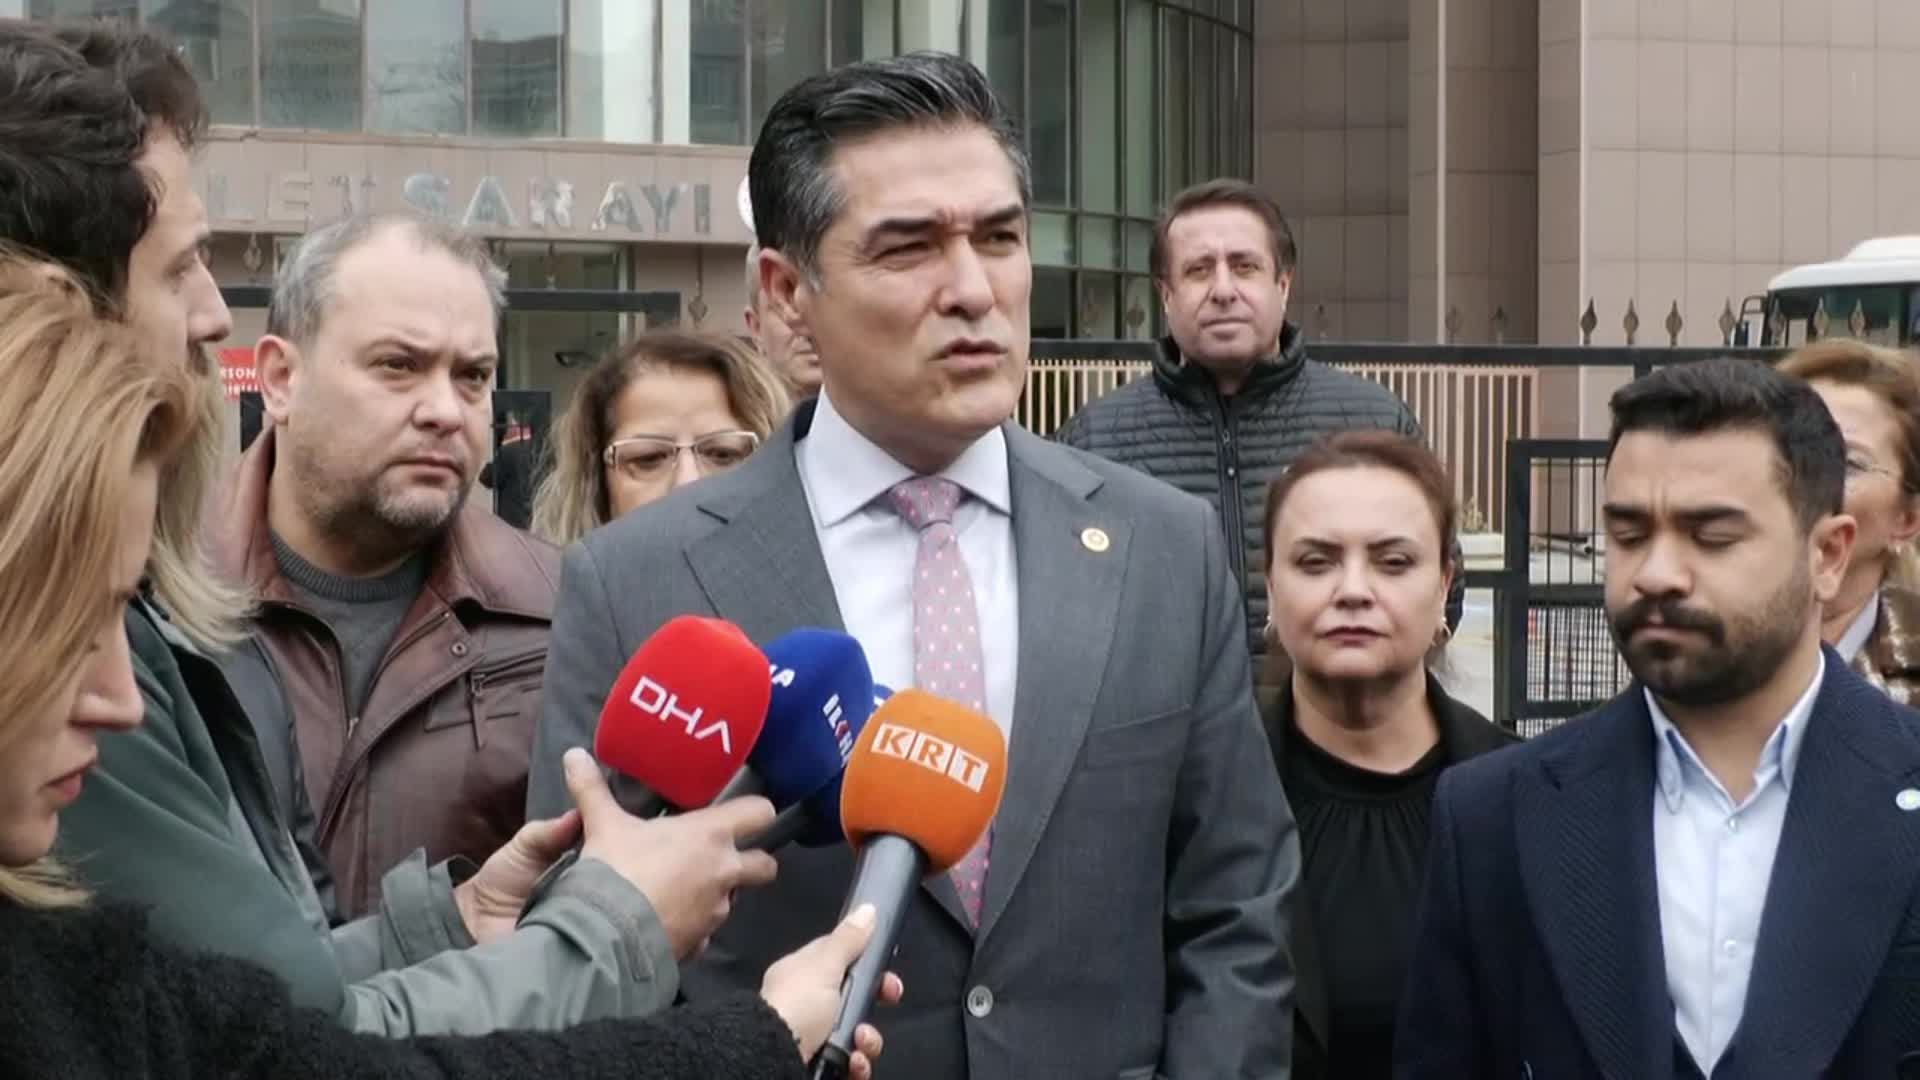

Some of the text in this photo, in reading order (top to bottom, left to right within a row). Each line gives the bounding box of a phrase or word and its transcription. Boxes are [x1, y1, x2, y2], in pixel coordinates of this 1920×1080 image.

[403, 173, 712, 234] SARAYI
[630, 676, 732, 753] DHA
[872, 723, 989, 794] KRT
